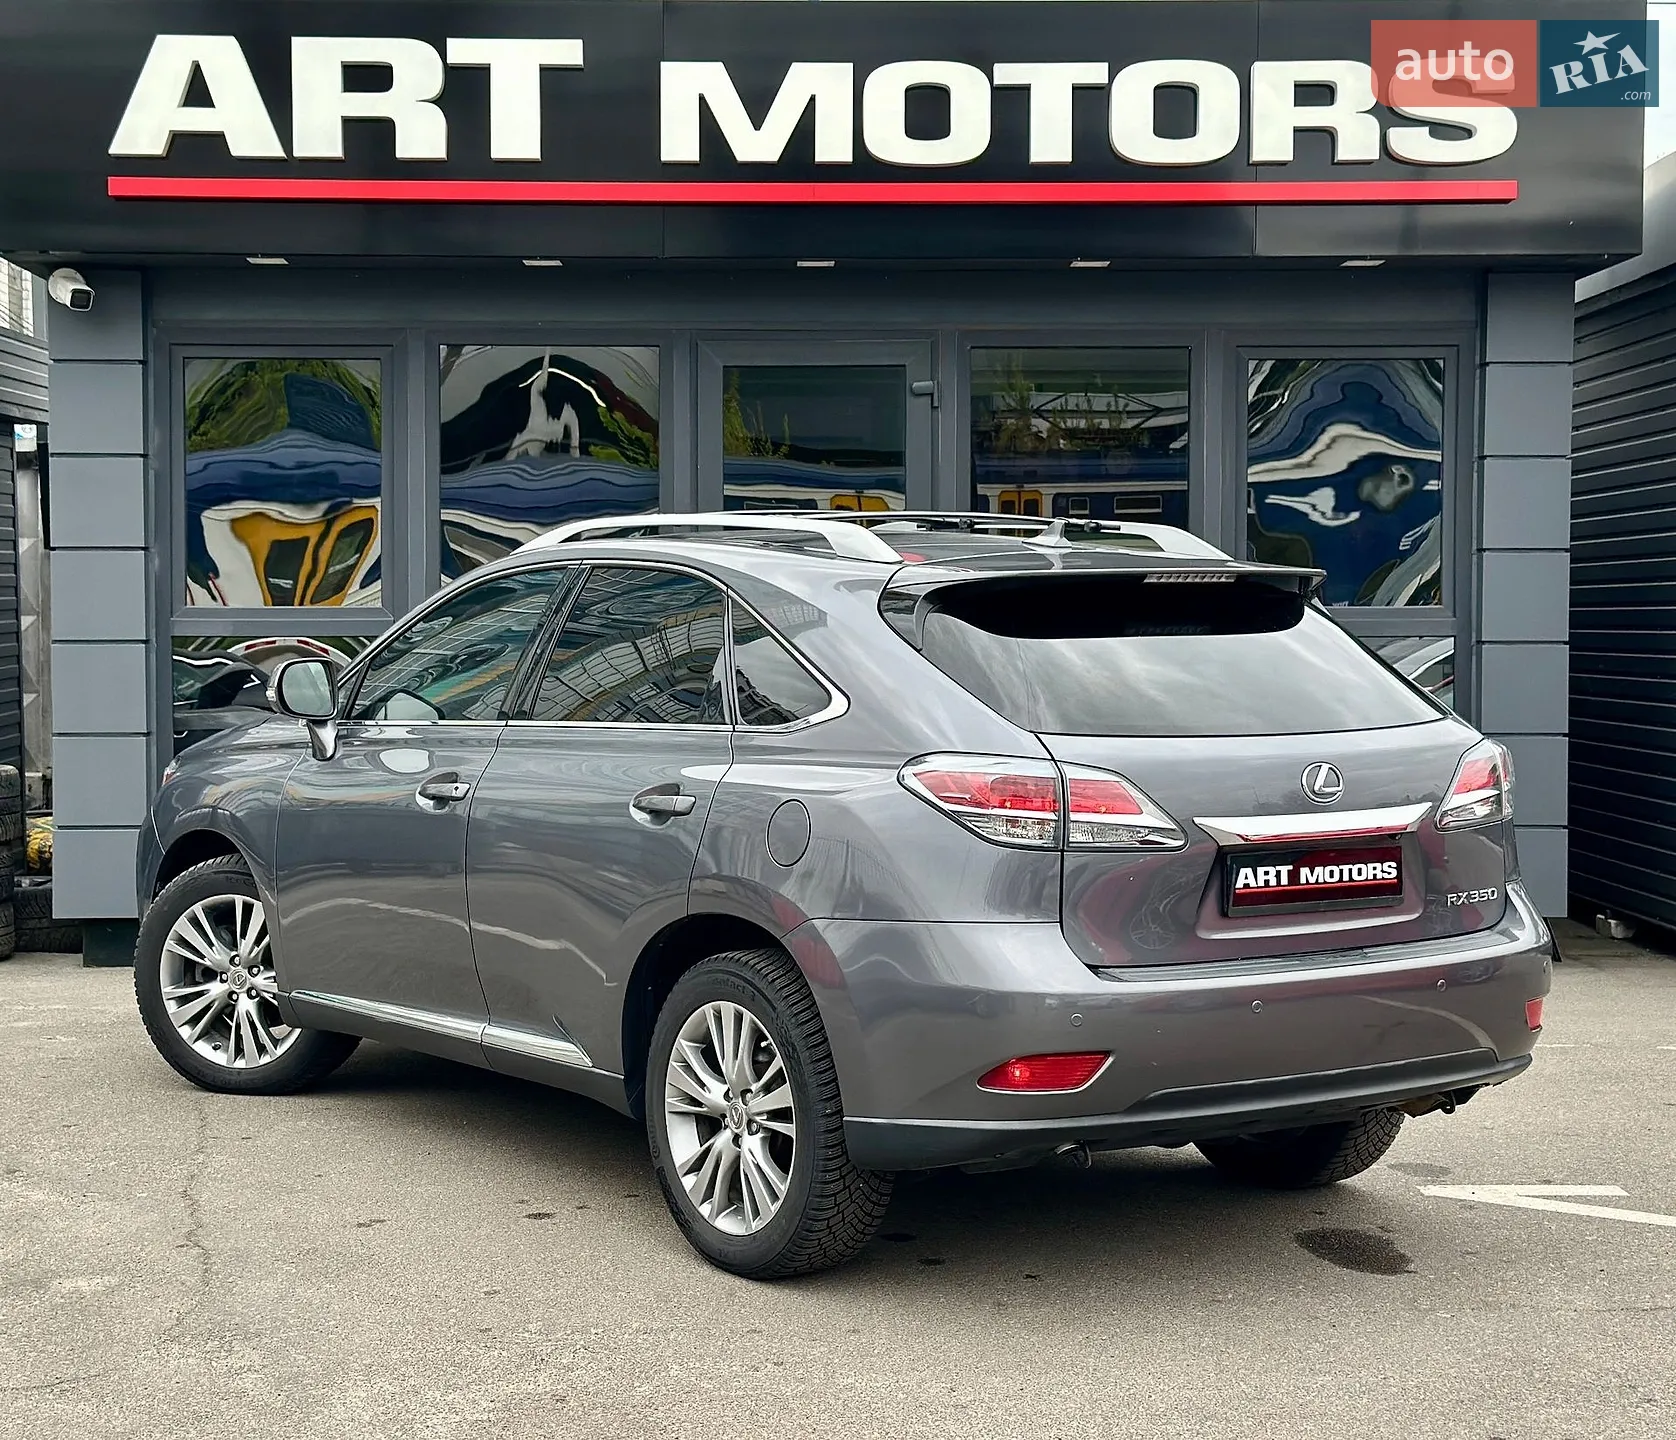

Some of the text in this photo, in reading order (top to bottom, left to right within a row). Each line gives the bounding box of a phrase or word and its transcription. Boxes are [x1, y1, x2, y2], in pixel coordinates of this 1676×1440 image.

[108, 33, 1519, 167] ART MOTORS
[1235, 861, 1398, 889] ART MOTORS
[1446, 887, 1498, 908] RX350
